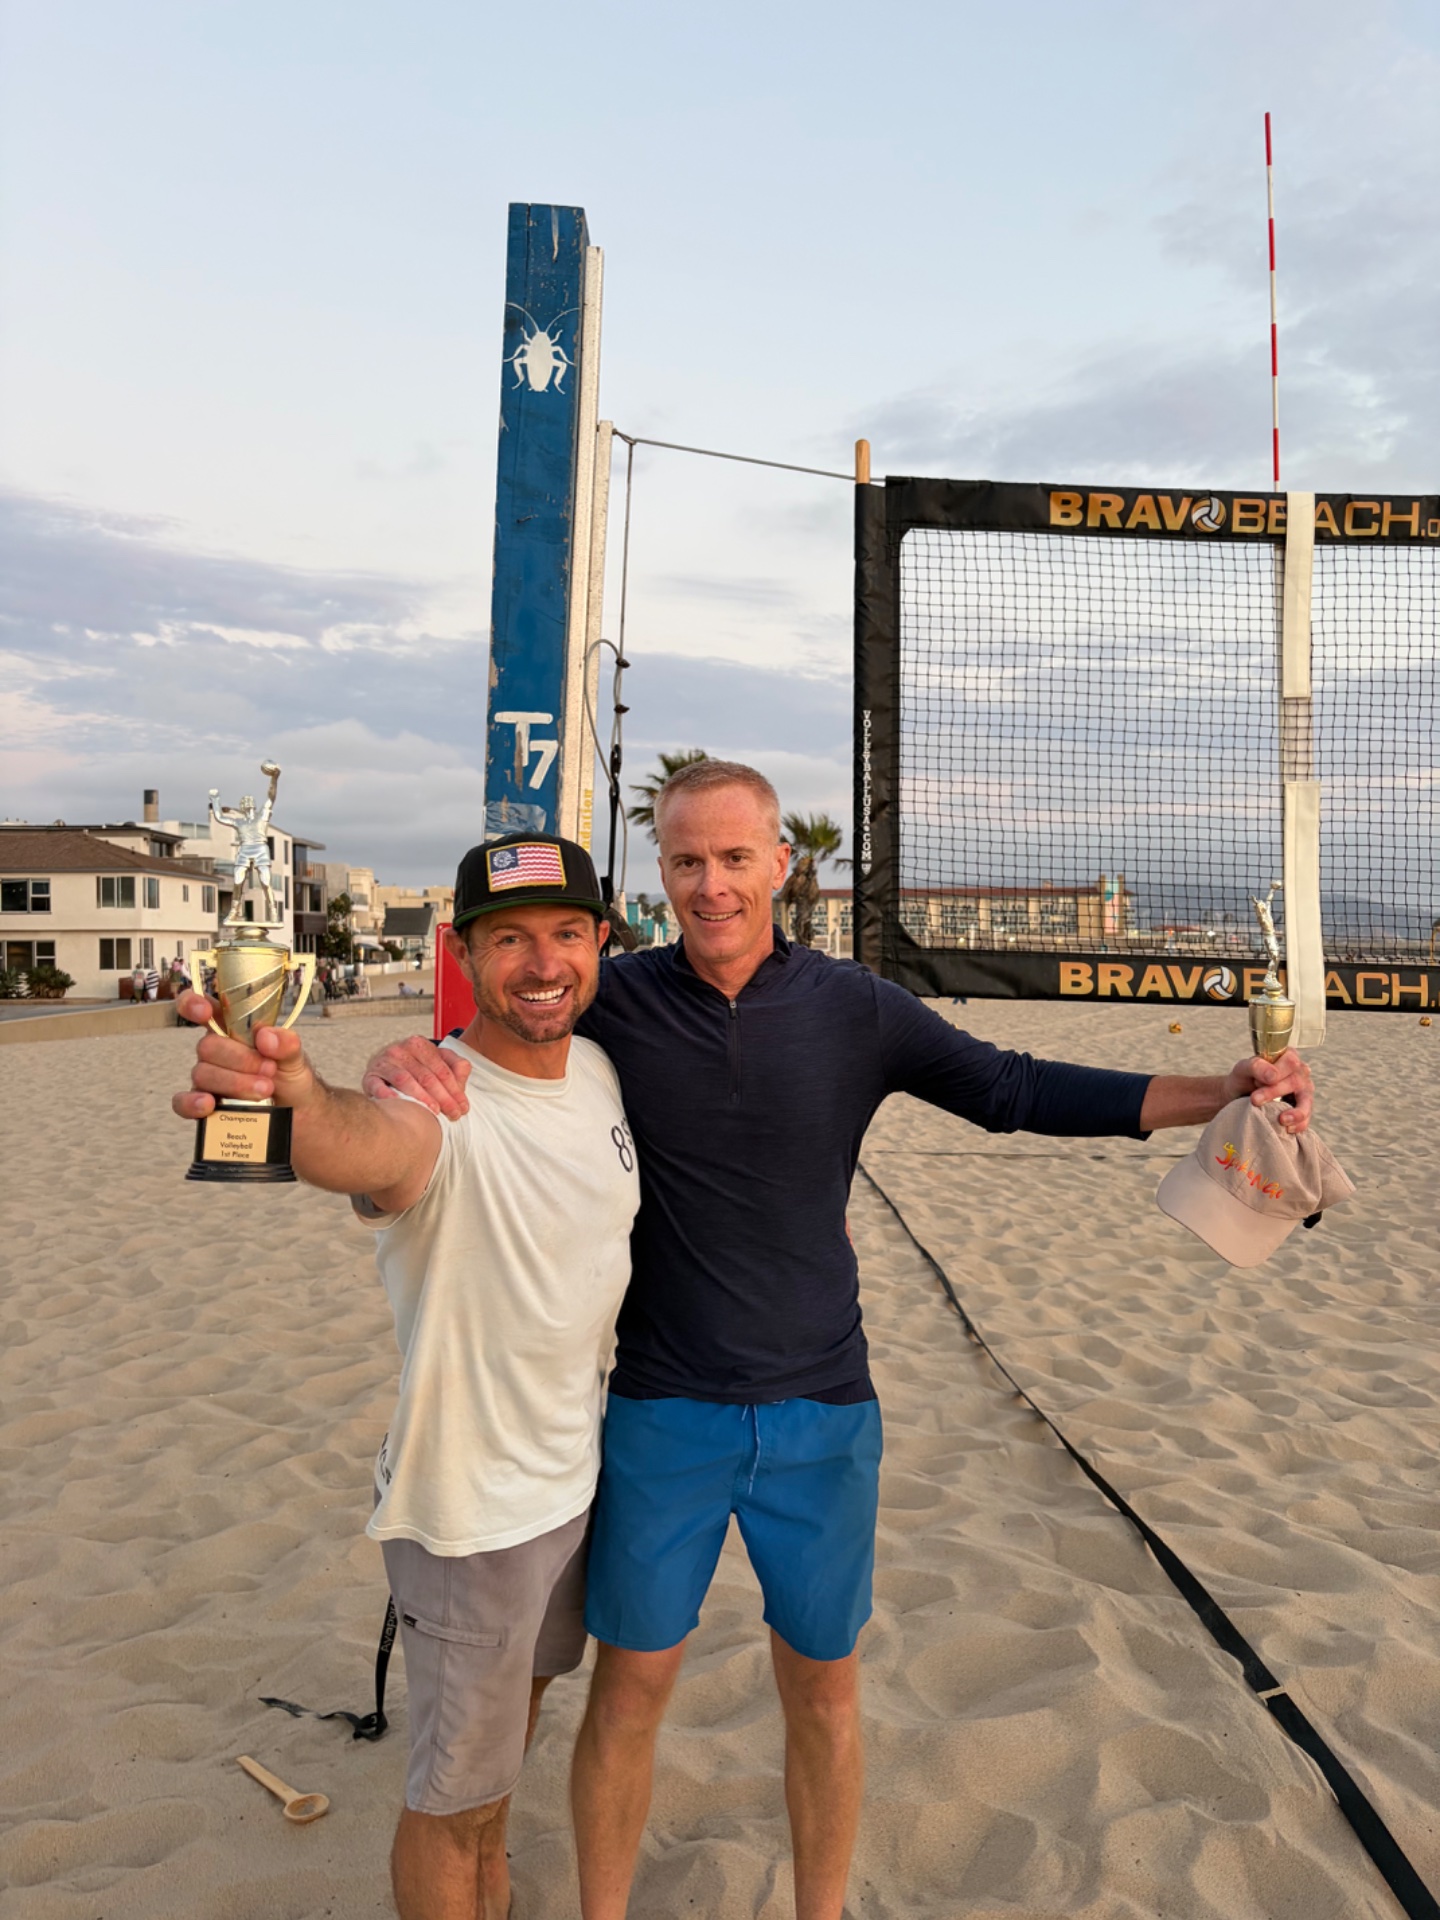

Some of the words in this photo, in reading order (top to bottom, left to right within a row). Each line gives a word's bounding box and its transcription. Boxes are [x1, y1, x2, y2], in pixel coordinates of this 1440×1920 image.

[219, 1114, 258, 1124] Champions
[226, 1132, 247, 1140] Beach
[220, 1141, 253, 1150] Volleyball
[232, 1151, 250, 1159] Place
